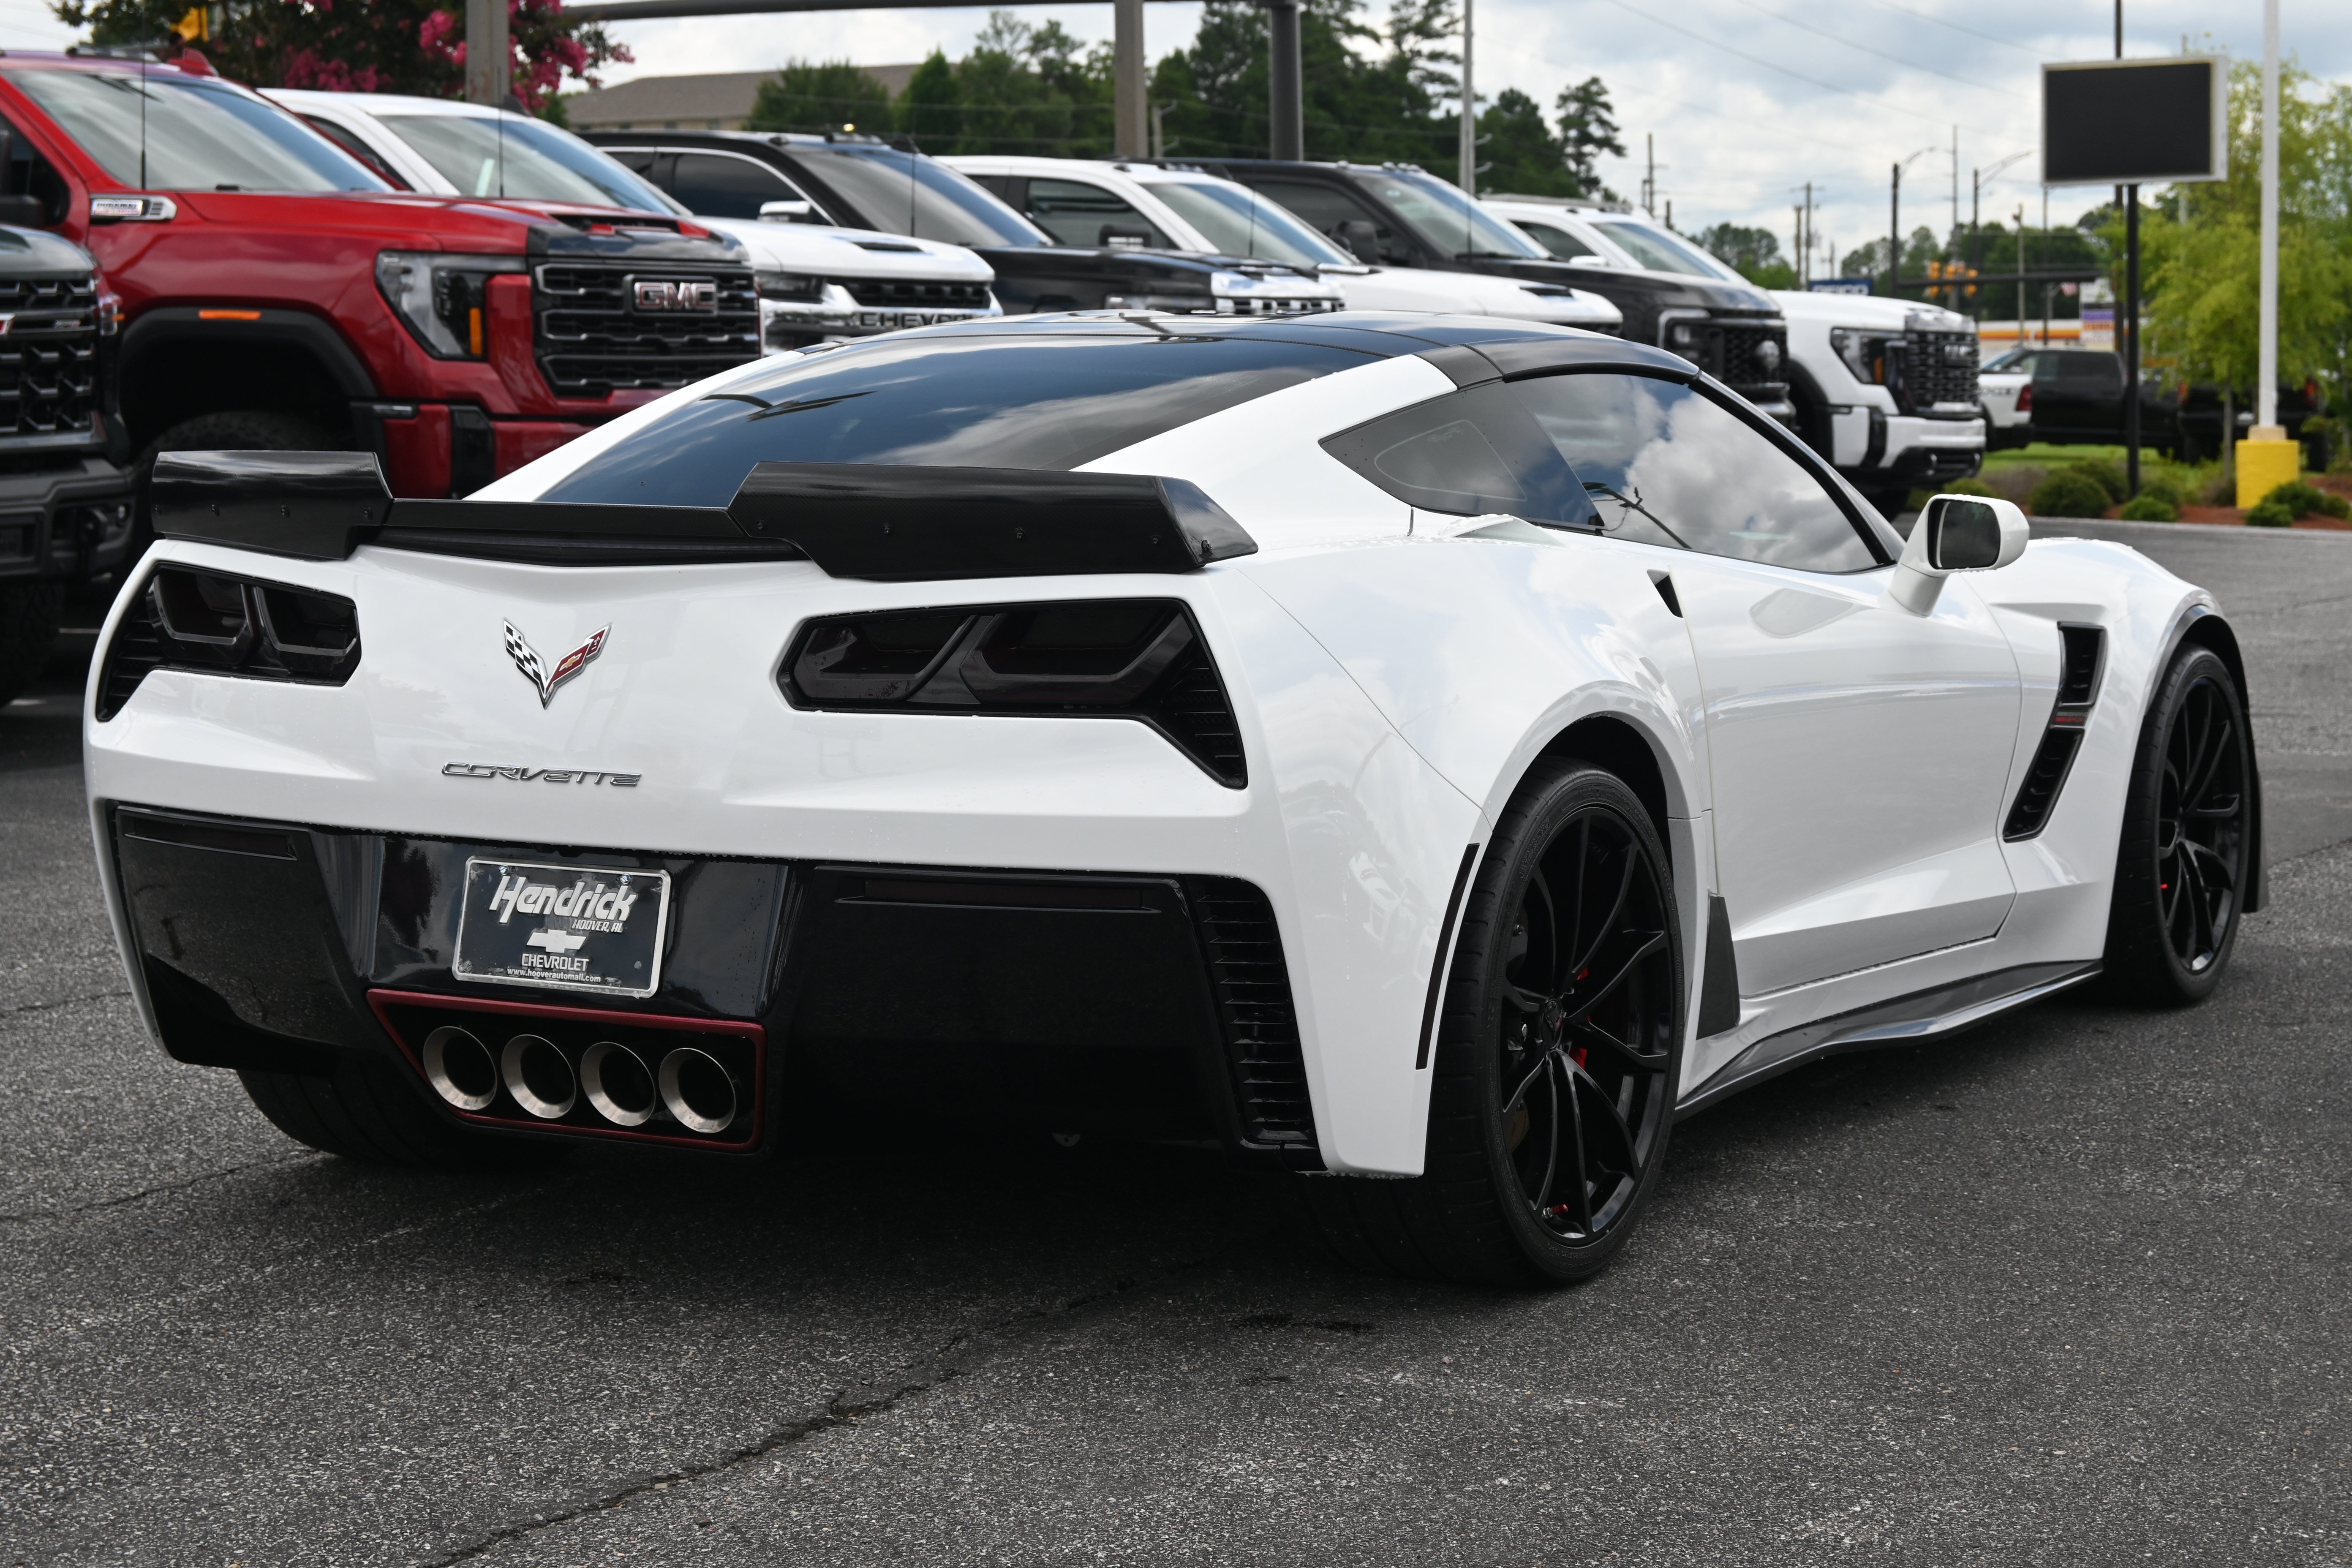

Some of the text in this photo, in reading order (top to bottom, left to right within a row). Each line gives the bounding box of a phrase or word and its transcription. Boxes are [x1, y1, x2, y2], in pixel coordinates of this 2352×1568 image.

[634, 282, 716, 309] GMC
[441, 761, 642, 787] CORVETTE
[489, 875, 637, 924] Hendrick
[571, 919, 623, 933] HOOVER, AL
[521, 953, 590, 972] CHEVROLET
[507, 967, 602, 983] www.hooverautomall.com
